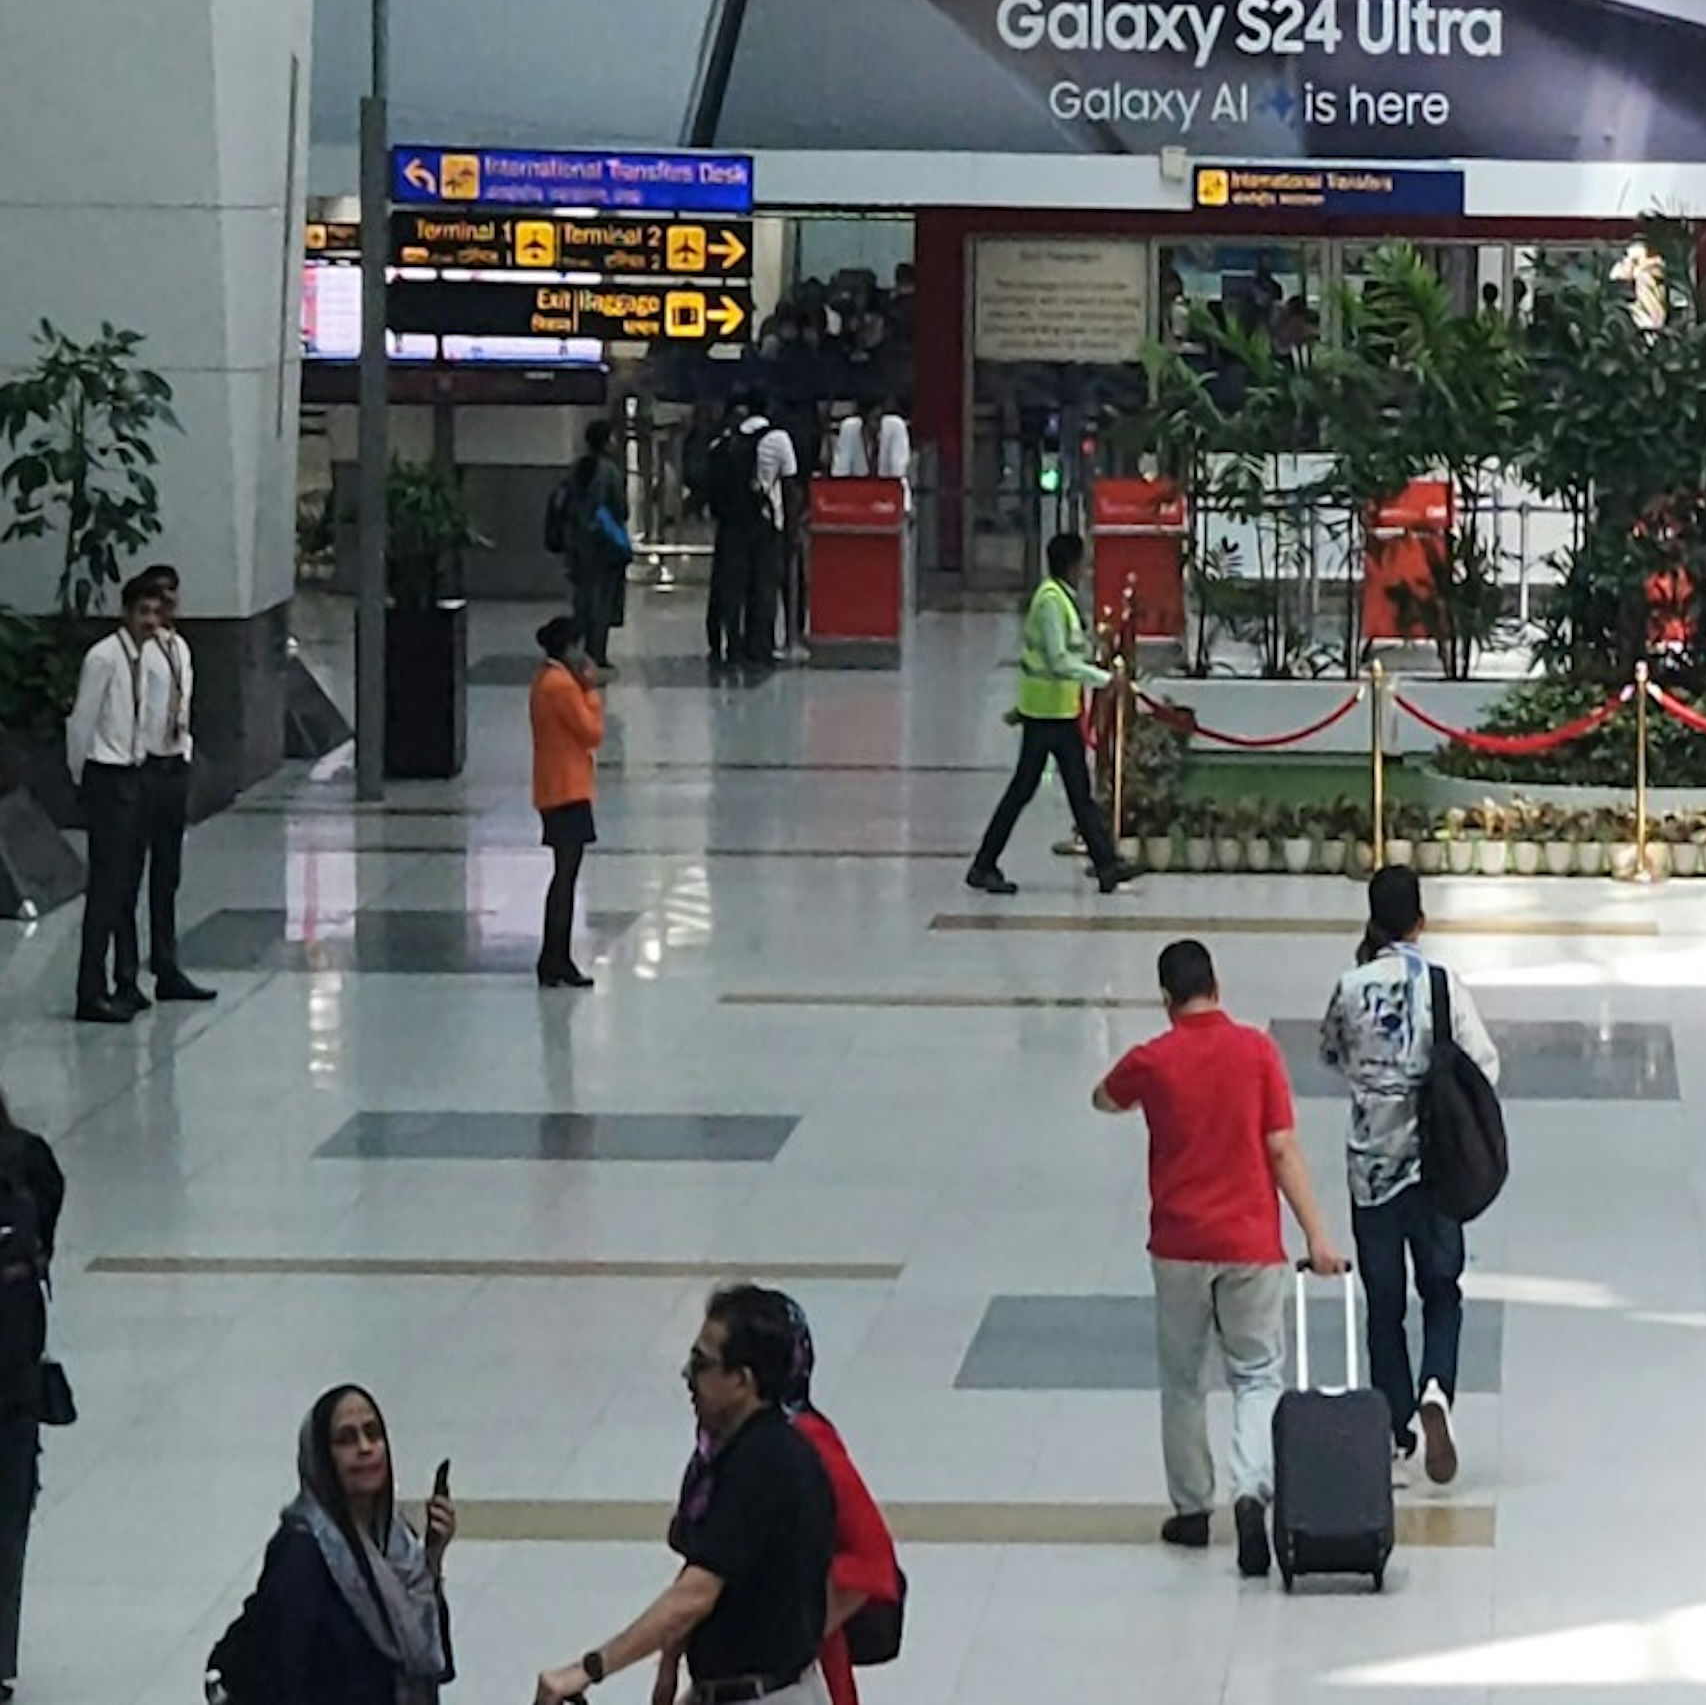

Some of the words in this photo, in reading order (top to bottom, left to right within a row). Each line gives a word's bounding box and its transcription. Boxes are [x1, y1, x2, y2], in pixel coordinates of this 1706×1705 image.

[1050, 81, 1202, 133] Galaxy
[1211, 84, 1248, 122] AI
[1305, 83, 1338, 124] is
[1350, 85, 1450, 125] here
[485, 158, 601, 180] International
[606, 160, 694, 184] Transfers
[699, 163, 748, 185] Desk
[1231, 171, 1323, 189] International
[416, 219, 496, 240] Terminal
[502, 222, 512, 243] 1
[564, 225, 643, 246] Terminal
[647, 226, 662, 246] 2
[536, 289, 571, 311] Exit
